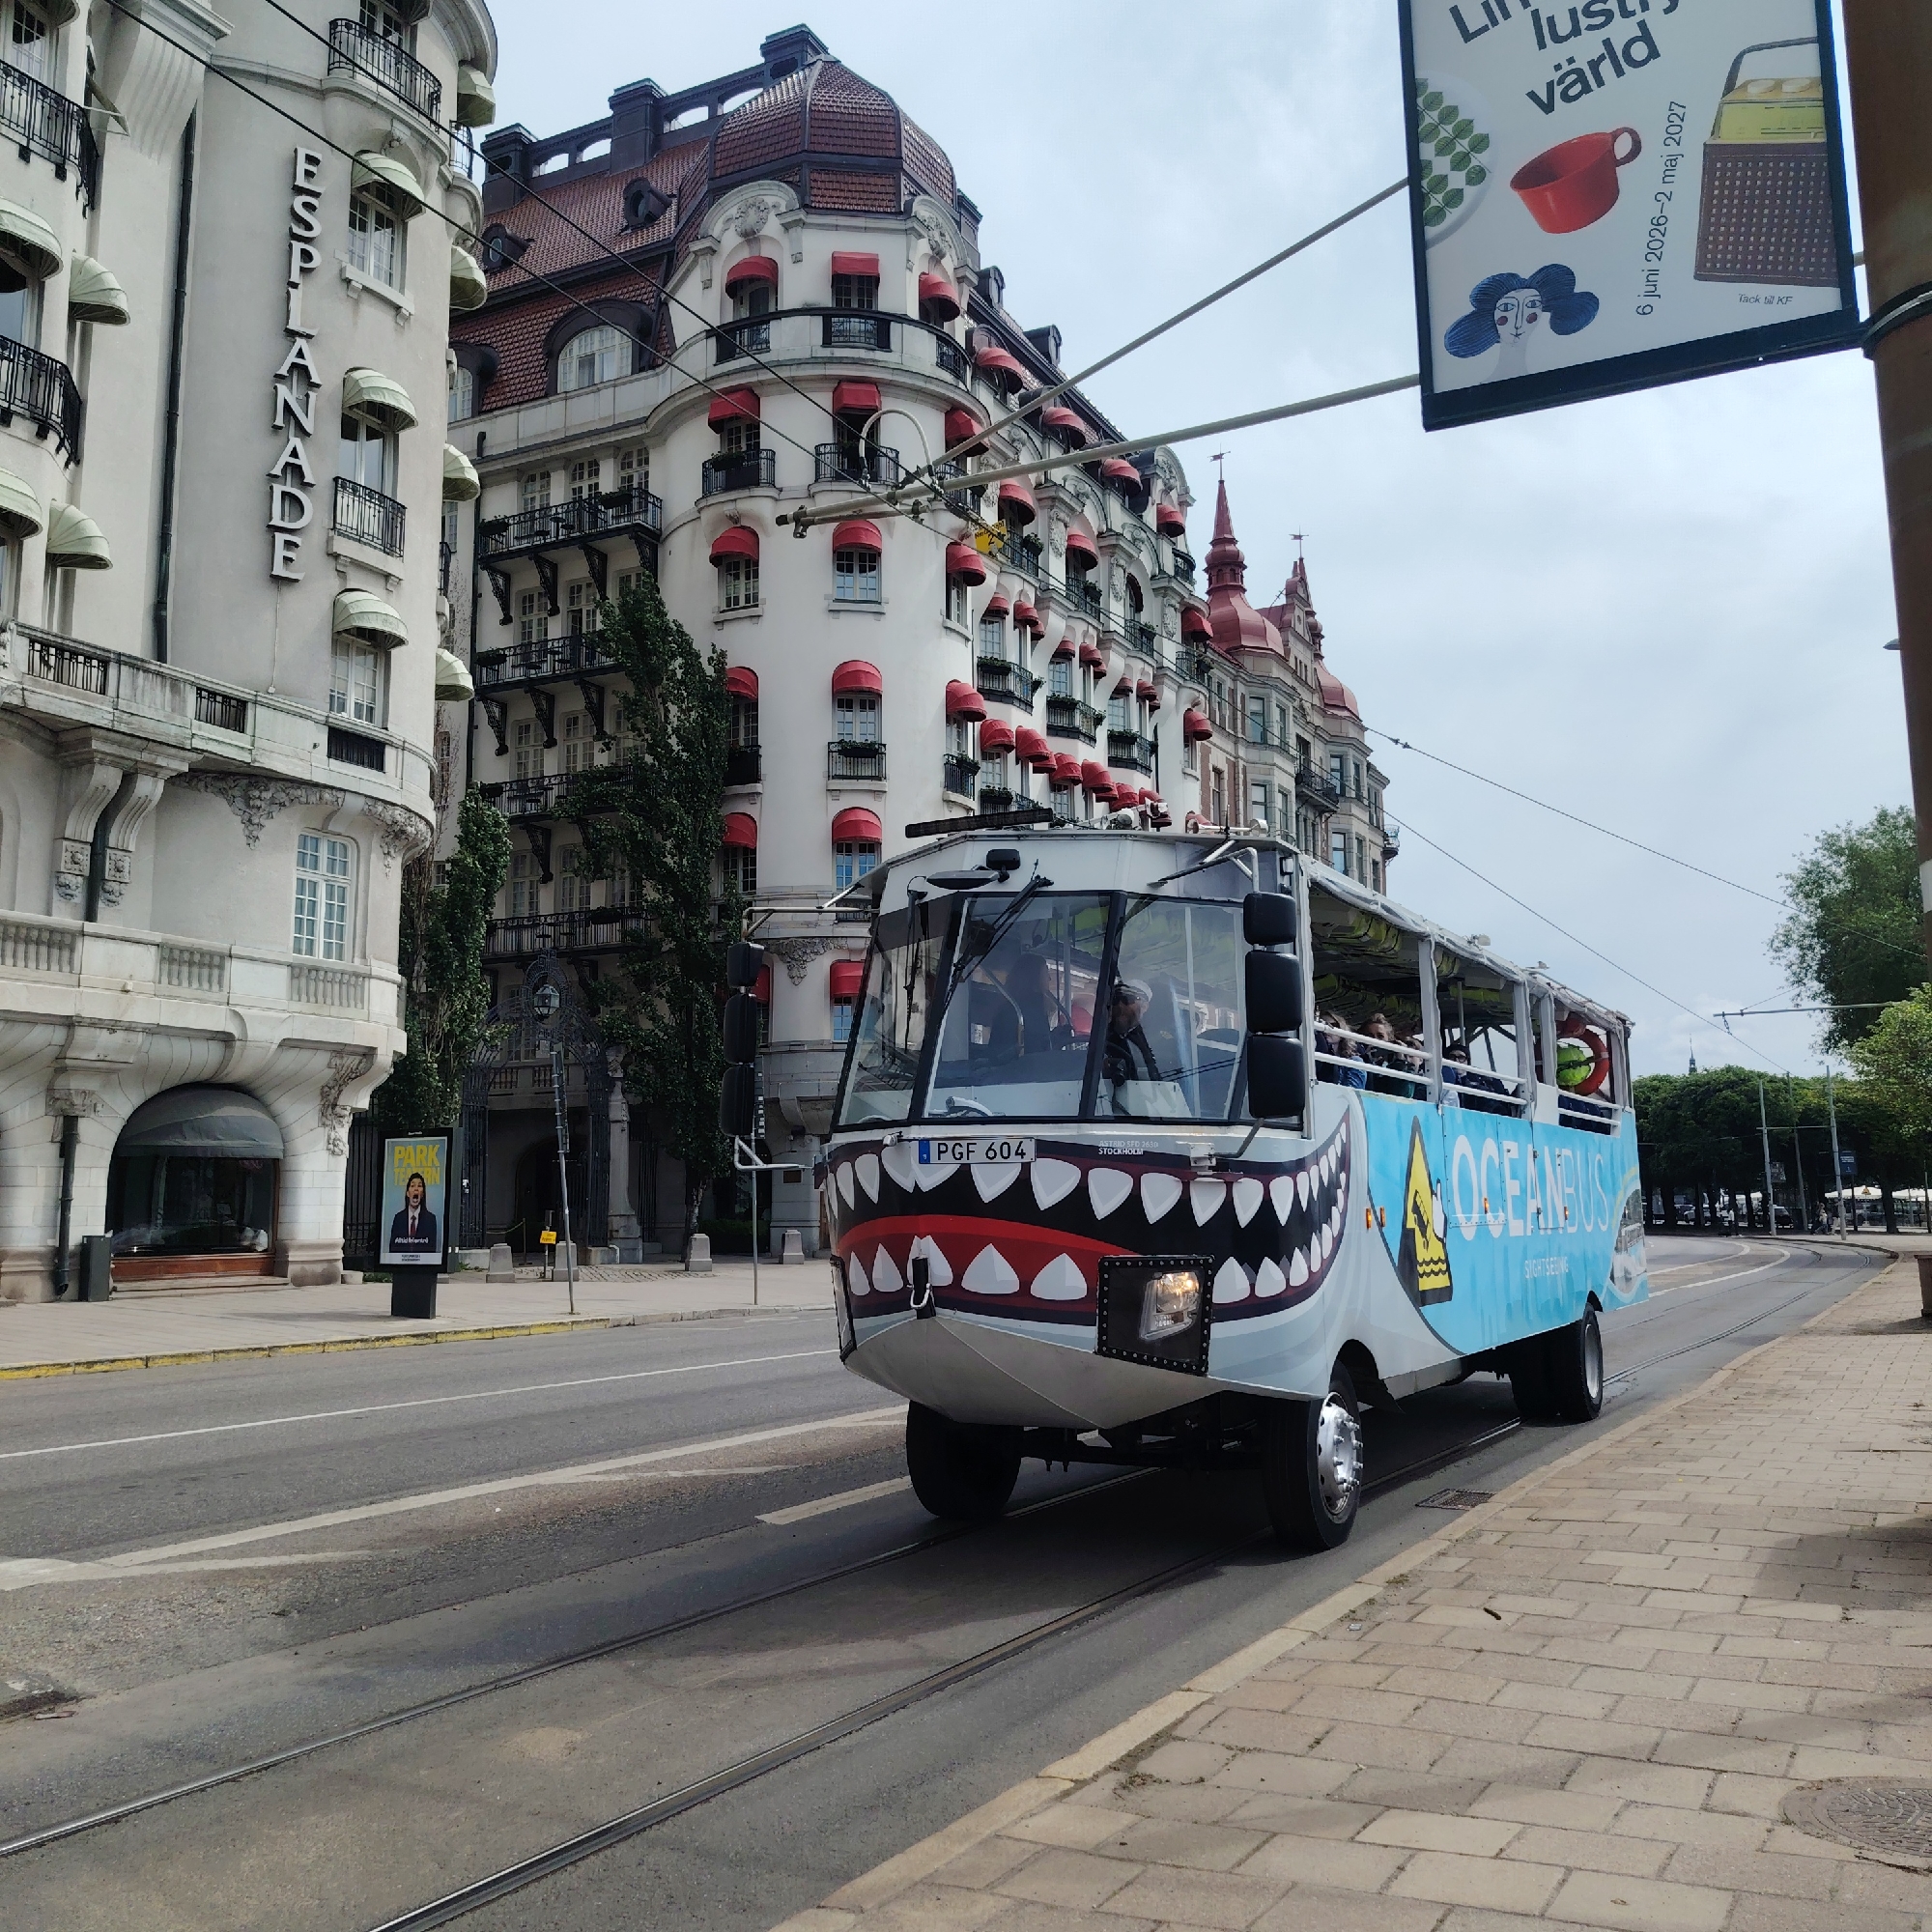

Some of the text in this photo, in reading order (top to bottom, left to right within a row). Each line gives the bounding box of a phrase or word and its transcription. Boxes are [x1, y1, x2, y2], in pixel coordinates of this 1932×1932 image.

[1525, 18, 1661, 115] värld
[1663, 100, 1687, 147] 2027
[1661, 154, 1685, 185] maj
[1637, 270, 1662, 298] juni
[1635, 303, 1654, 316] 6
[1739, 293, 1793, 305] Tack till KF
[267, 146, 324, 582] ESPLANADE
[937, 1140, 1026, 1161] PGF 604
[1098, 1140, 1125, 1149] ASTRID
[1098, 1147, 1144, 1155] STOCKHOLM
[394, 1145, 440, 1167] PARK
